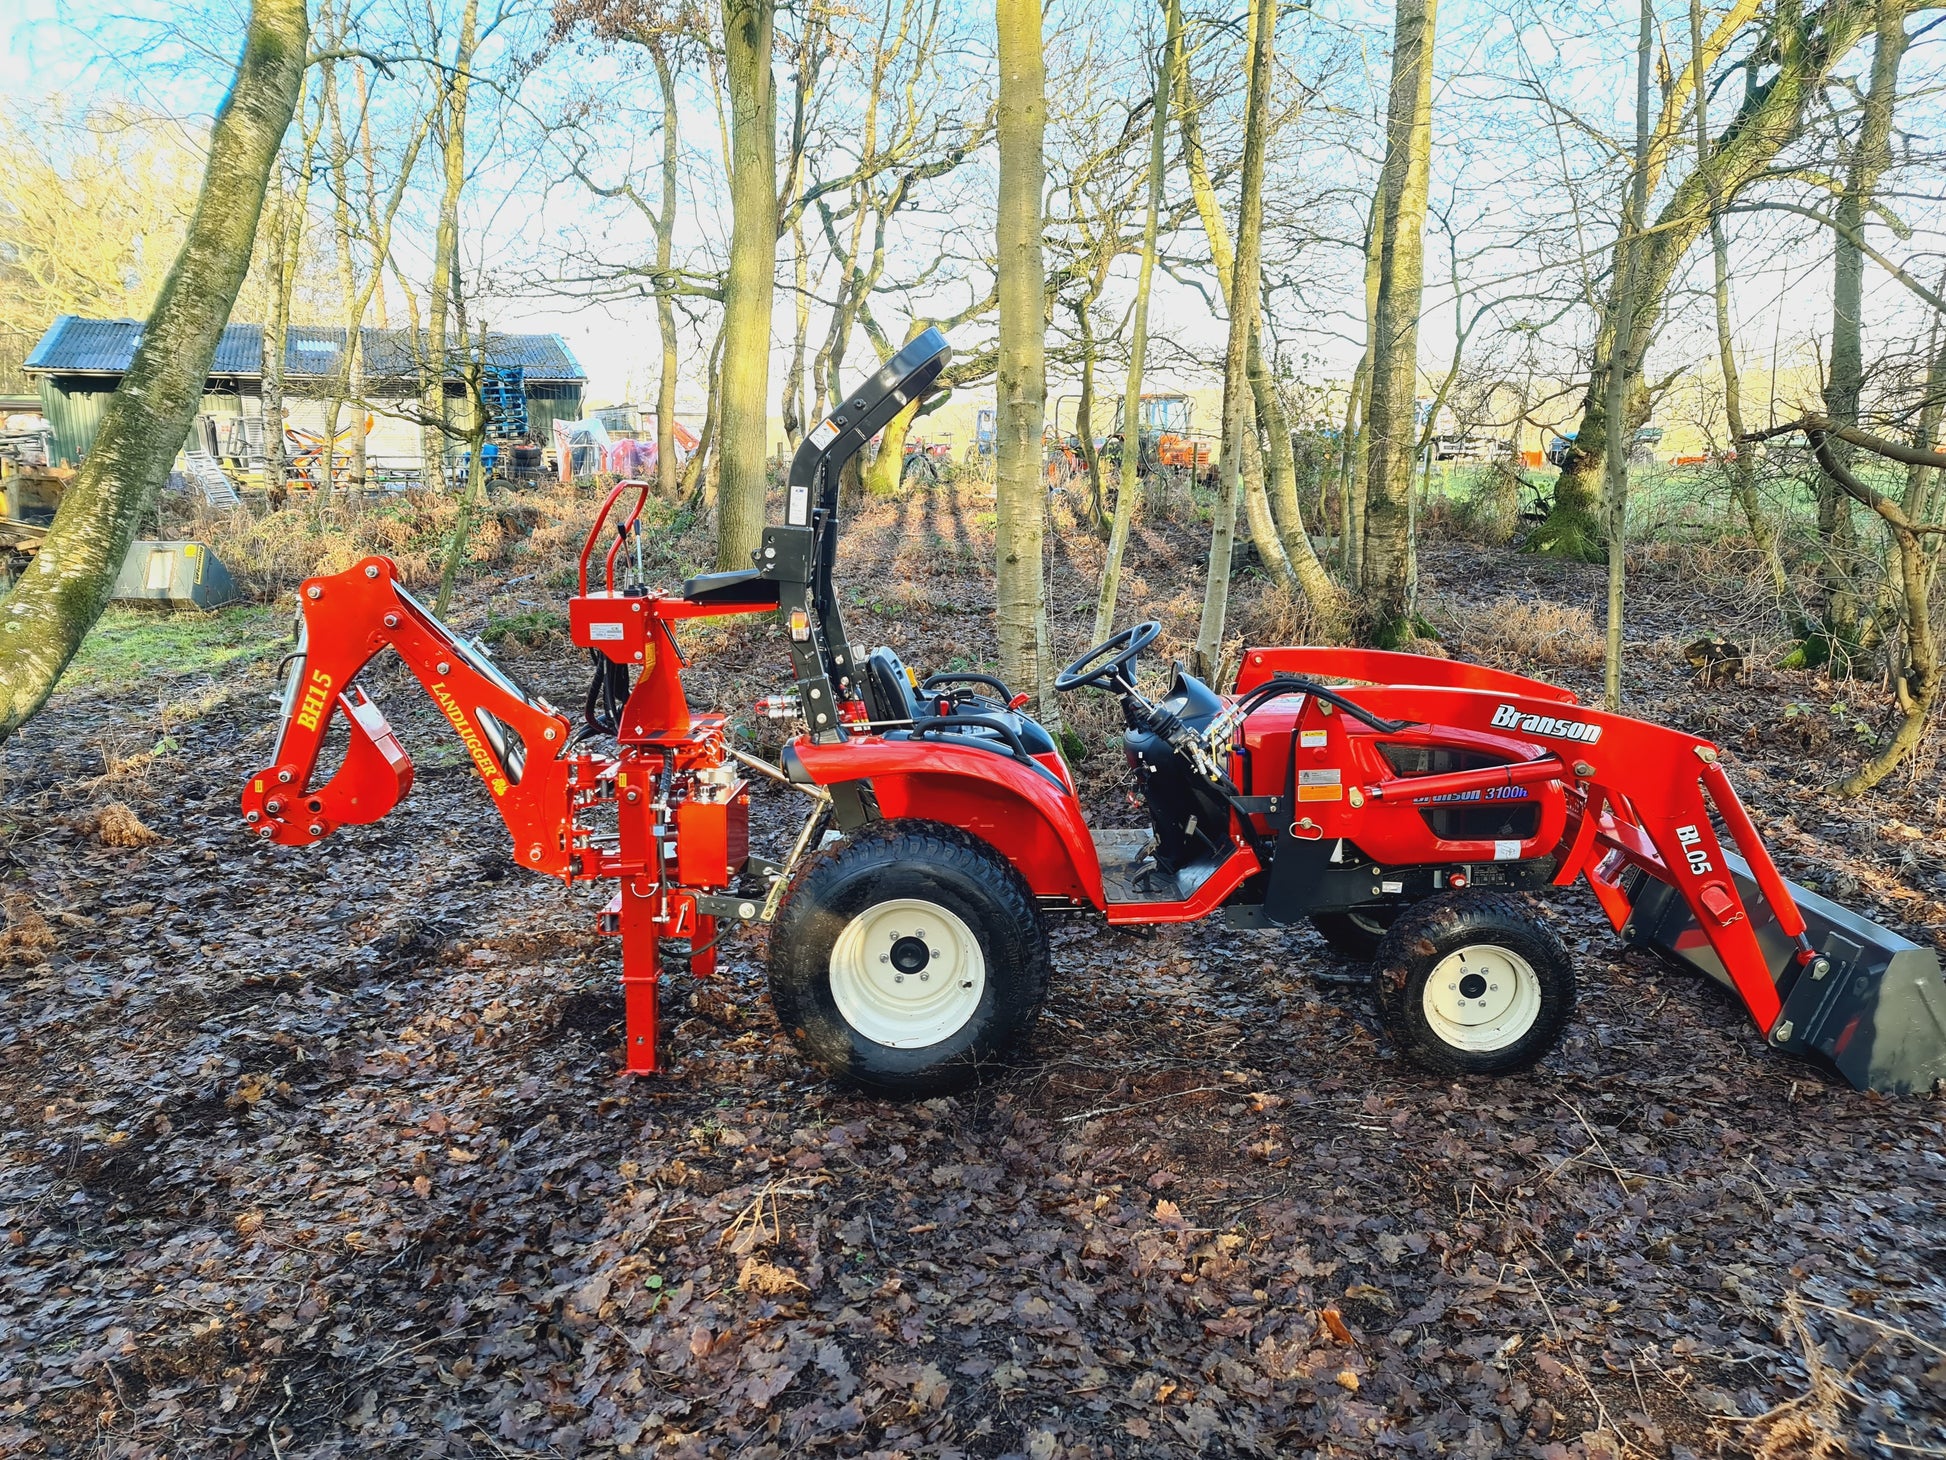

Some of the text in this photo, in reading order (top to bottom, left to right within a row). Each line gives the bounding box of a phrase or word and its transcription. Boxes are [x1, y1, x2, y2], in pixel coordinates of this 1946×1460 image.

[297, 669, 332, 732] BH15
[1490, 703, 1603, 745] Branson
[431, 682, 497, 777] LANDLUGGER
[1485, 786, 1528, 799] 3100h
[1675, 824, 1713, 875] BL05
